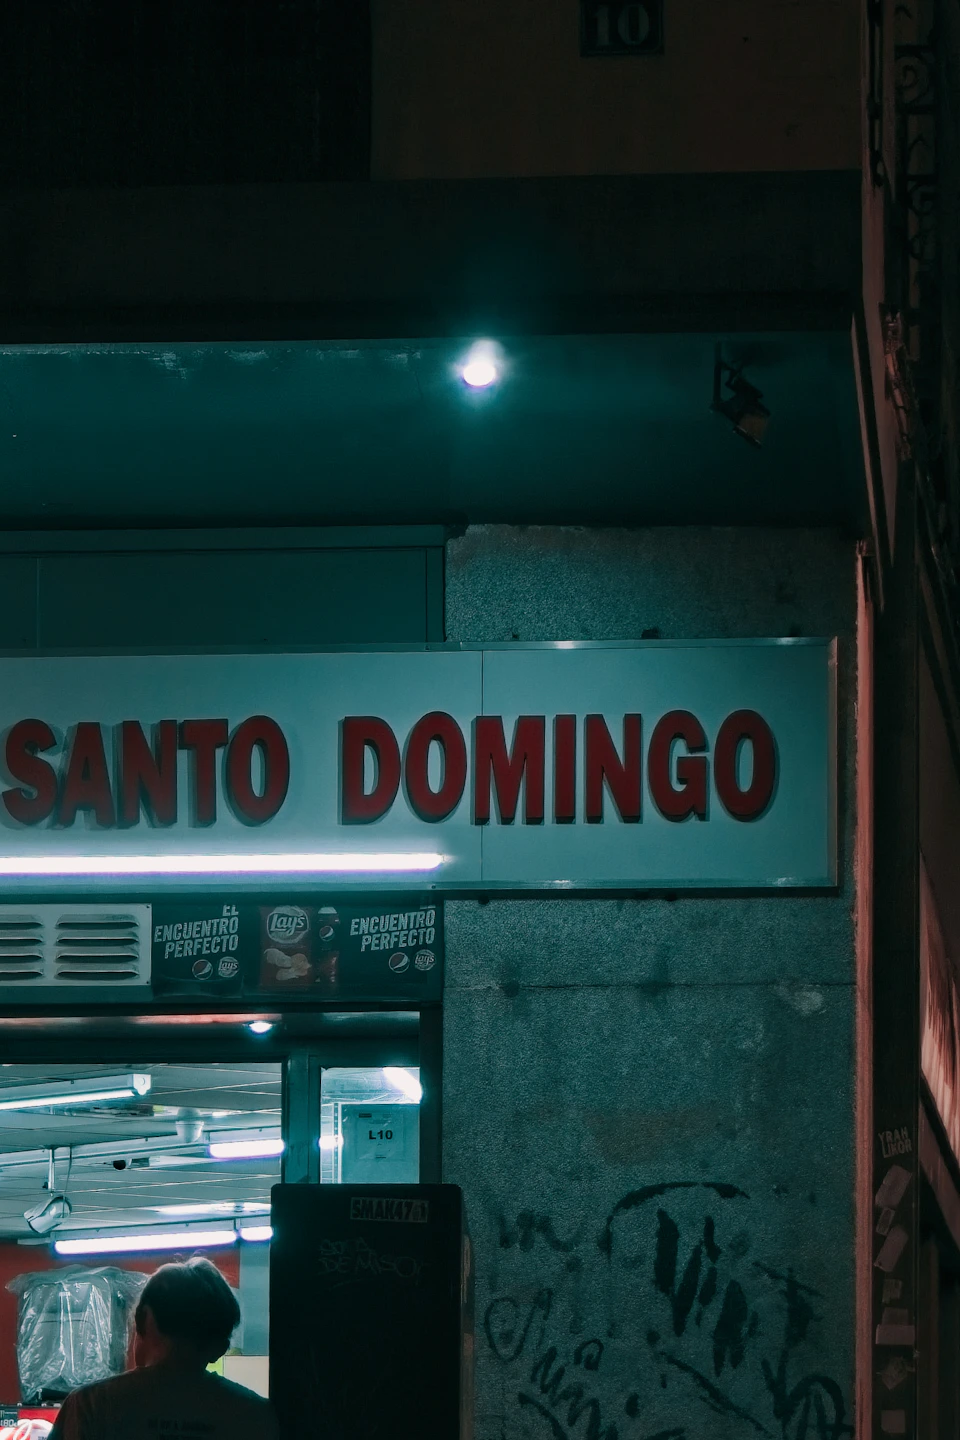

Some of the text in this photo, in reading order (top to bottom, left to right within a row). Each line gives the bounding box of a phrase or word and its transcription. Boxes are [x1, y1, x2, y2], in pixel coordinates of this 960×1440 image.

[596, 3, 650, 46] 10
[0, 714, 291, 828] SANTO
[339, 708, 778, 826] DOMINGO
[153, 916, 239, 942] ENCUENTRO
[349, 909, 436, 936] ENCUENTRO
[164, 934, 239, 959] PERFECTO
[360, 927, 436, 952] PERFECTO
[368, 1129, 394, 1140] L10
